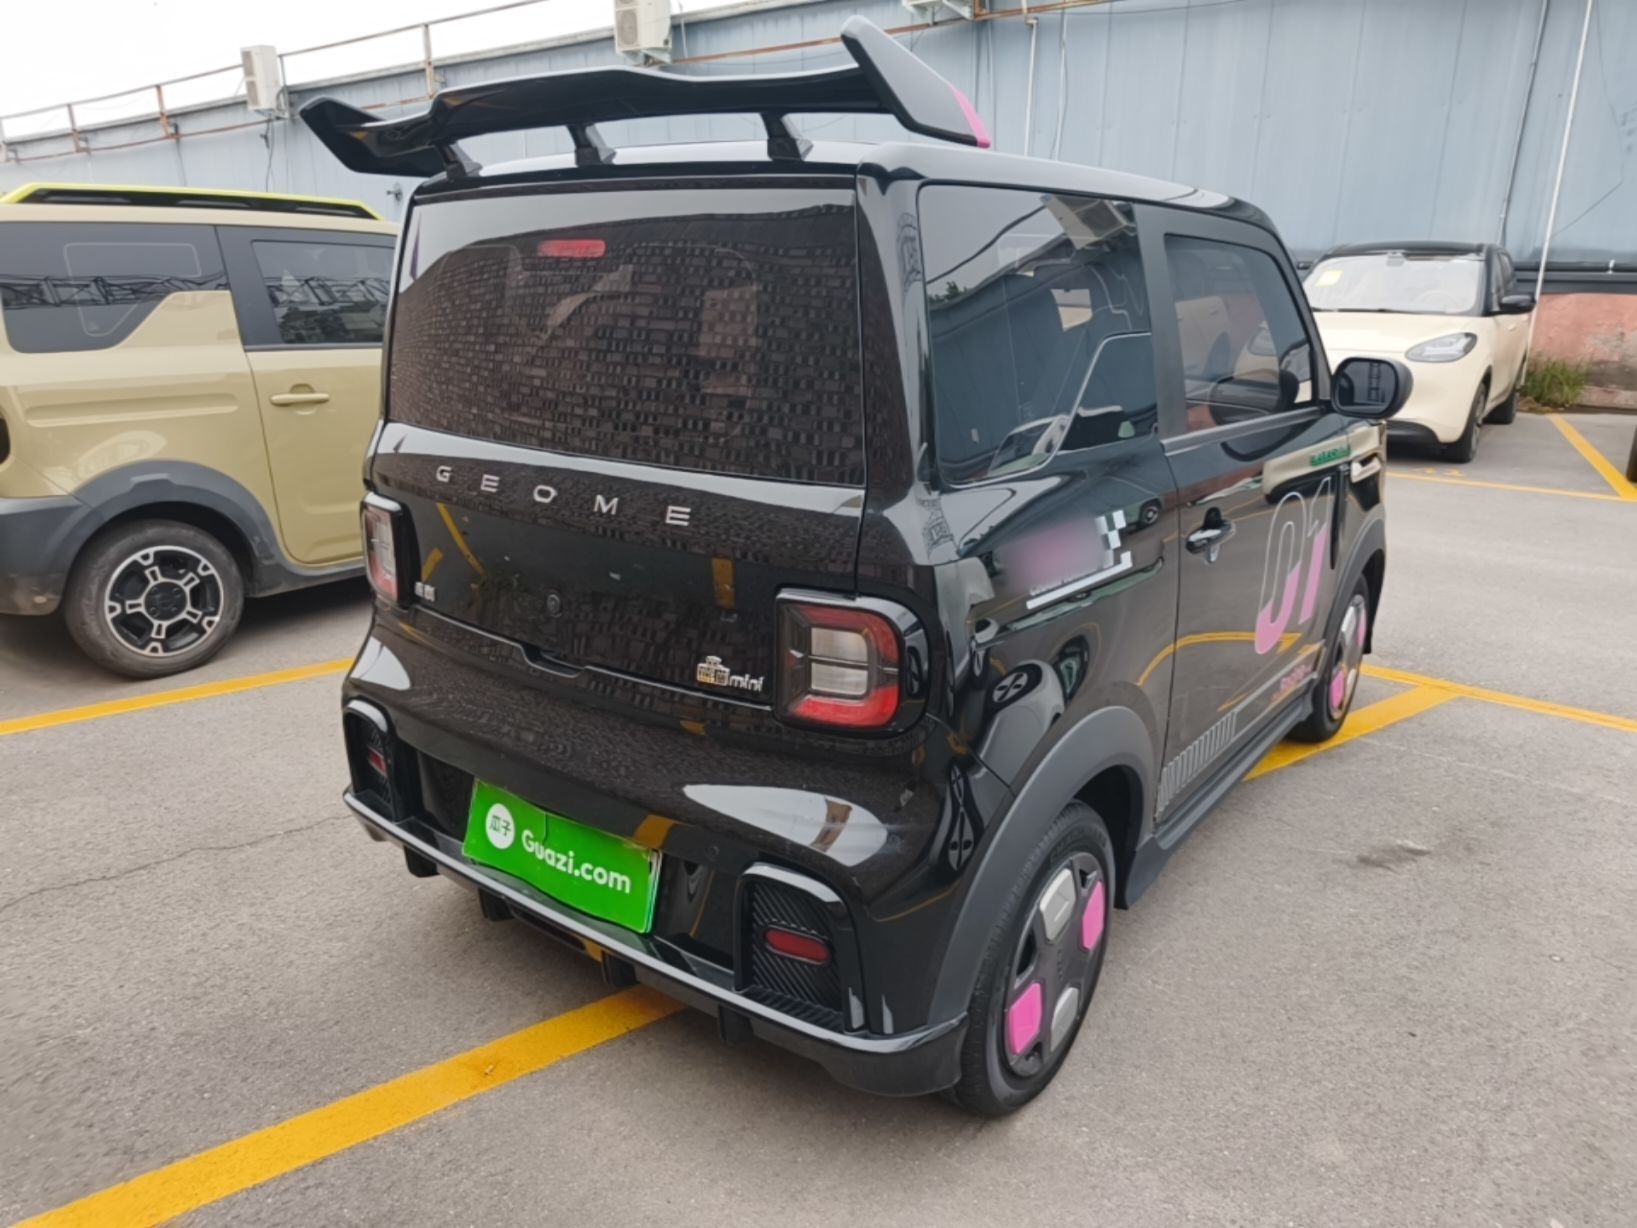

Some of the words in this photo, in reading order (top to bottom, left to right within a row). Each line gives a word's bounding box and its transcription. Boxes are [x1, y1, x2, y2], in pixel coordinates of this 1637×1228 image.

[436, 465, 692, 527] GEOME
[1255, 476, 1331, 655] 01
[729, 673, 764, 692] mini
[521, 829, 632, 895] Guazi.com
